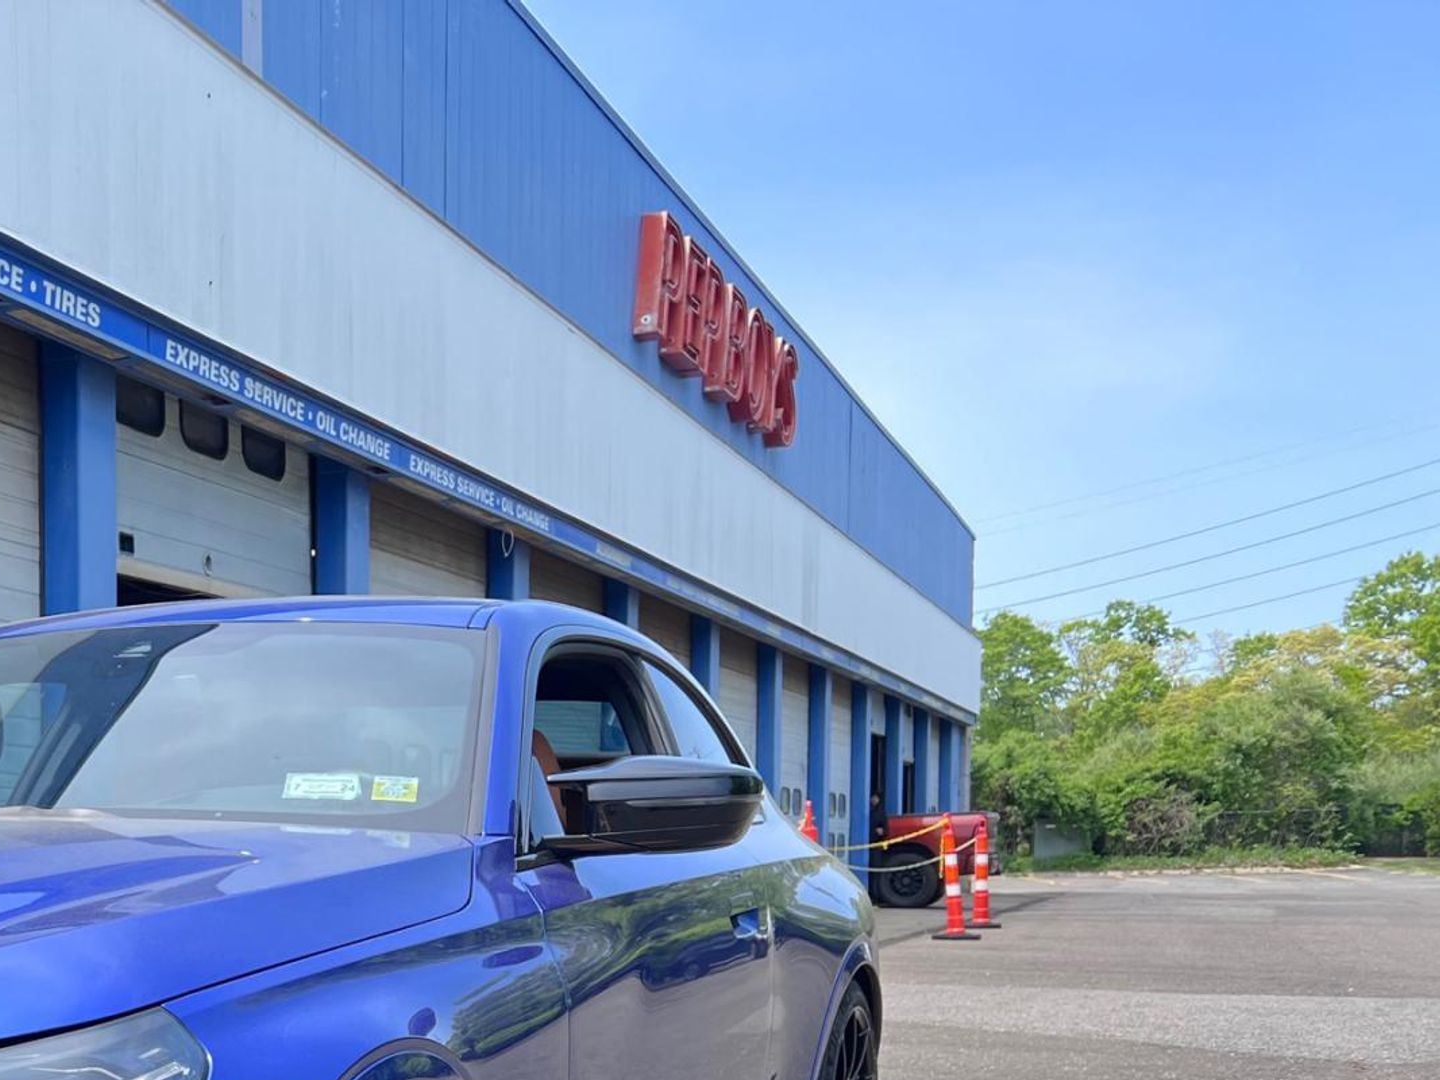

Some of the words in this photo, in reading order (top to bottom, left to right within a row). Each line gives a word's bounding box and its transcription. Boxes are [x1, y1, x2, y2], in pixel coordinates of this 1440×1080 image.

[42, 280, 101, 328] TIRES
[165, 338, 240, 392] EXPRESS
[244, 376, 305, 422] SERVICE
[316, 411, 337, 435] OIL
[339, 421, 391, 460] CHANGE
[409, 453, 456, 490] EXPRESS
[457, 477, 495, 507] SERVICE
[516, 503, 550, 531] CHANGE
